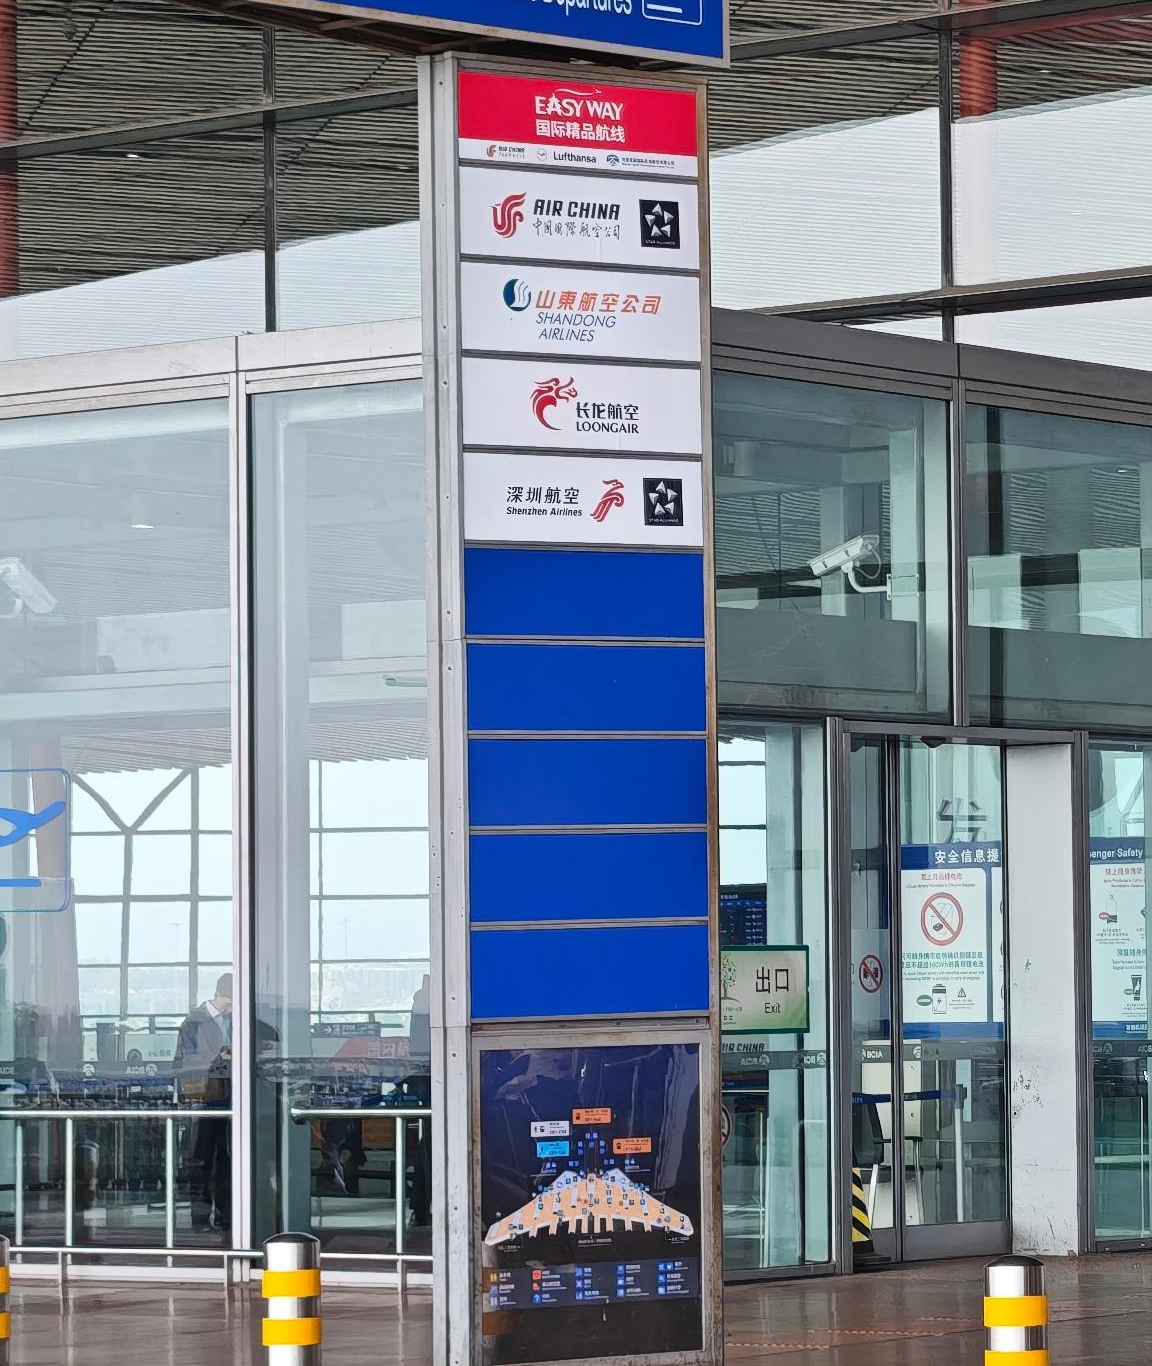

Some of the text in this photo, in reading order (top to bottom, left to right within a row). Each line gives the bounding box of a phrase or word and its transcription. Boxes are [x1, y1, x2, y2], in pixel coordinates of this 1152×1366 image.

[535, 93, 624, 121] EASY WAY
[535, 119, 625, 143] 国际精品航线
[553, 150, 597, 164] Lufthansa
[533, 199, 620, 221] AIR CHINA
[536, 311, 617, 328] SHANDONG
[538, 328, 595, 342] AIRLINES
[576, 401, 639, 421] 长龙航空
[576, 421, 639, 434] LOONGAIR
[506, 486, 580, 505] 深圳航空
[506, 506, 583, 517] Shenzhen Airlines
[934, 848, 1000, 864] 安全信息提
[1117, 848, 1144, 859] Safety
[755, 966, 790, 994] 出口
[764, 1002, 781, 1014] Exit
[736, 1043, 765, 1052] CHINA
